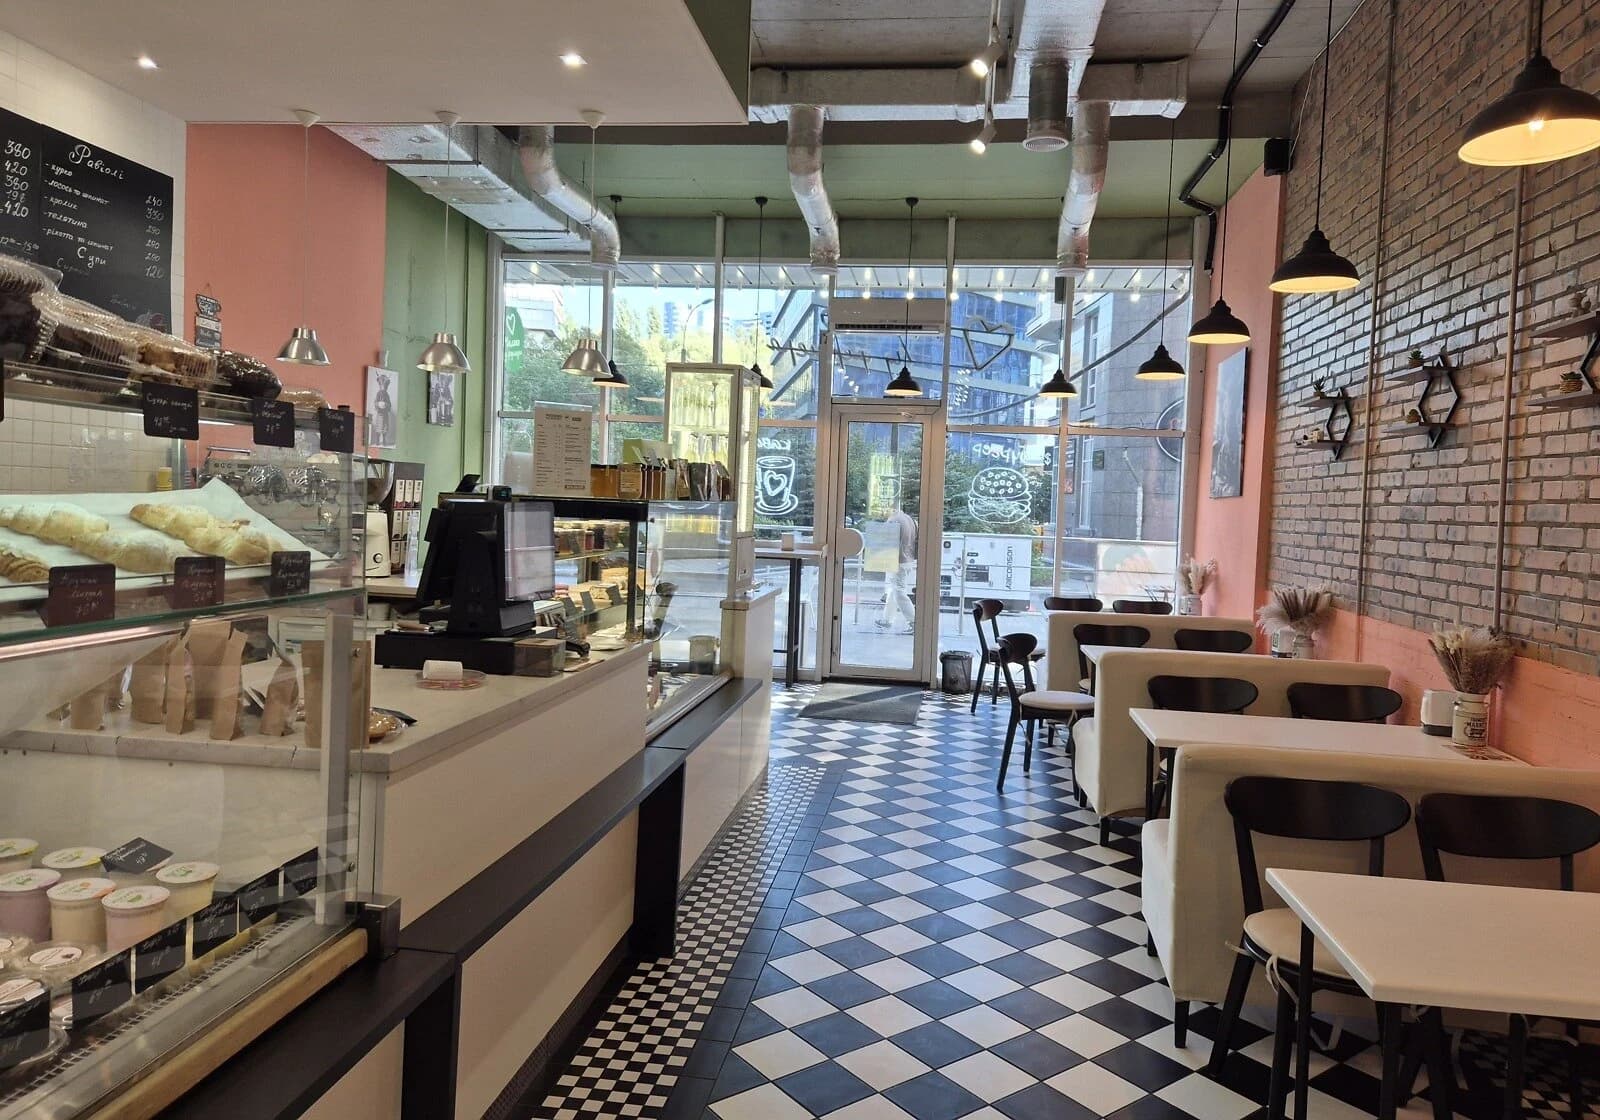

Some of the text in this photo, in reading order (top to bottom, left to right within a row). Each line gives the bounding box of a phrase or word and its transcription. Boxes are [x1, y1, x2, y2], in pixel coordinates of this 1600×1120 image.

[5, 140, 31, 159] 380
[5, 160, 28, 176] 420
[69, 144, 124, 180] Равіолі
[5, 175, 29, 191] 380
[5, 201, 29, 218] 420
[77, 246, 106, 269] Супи
